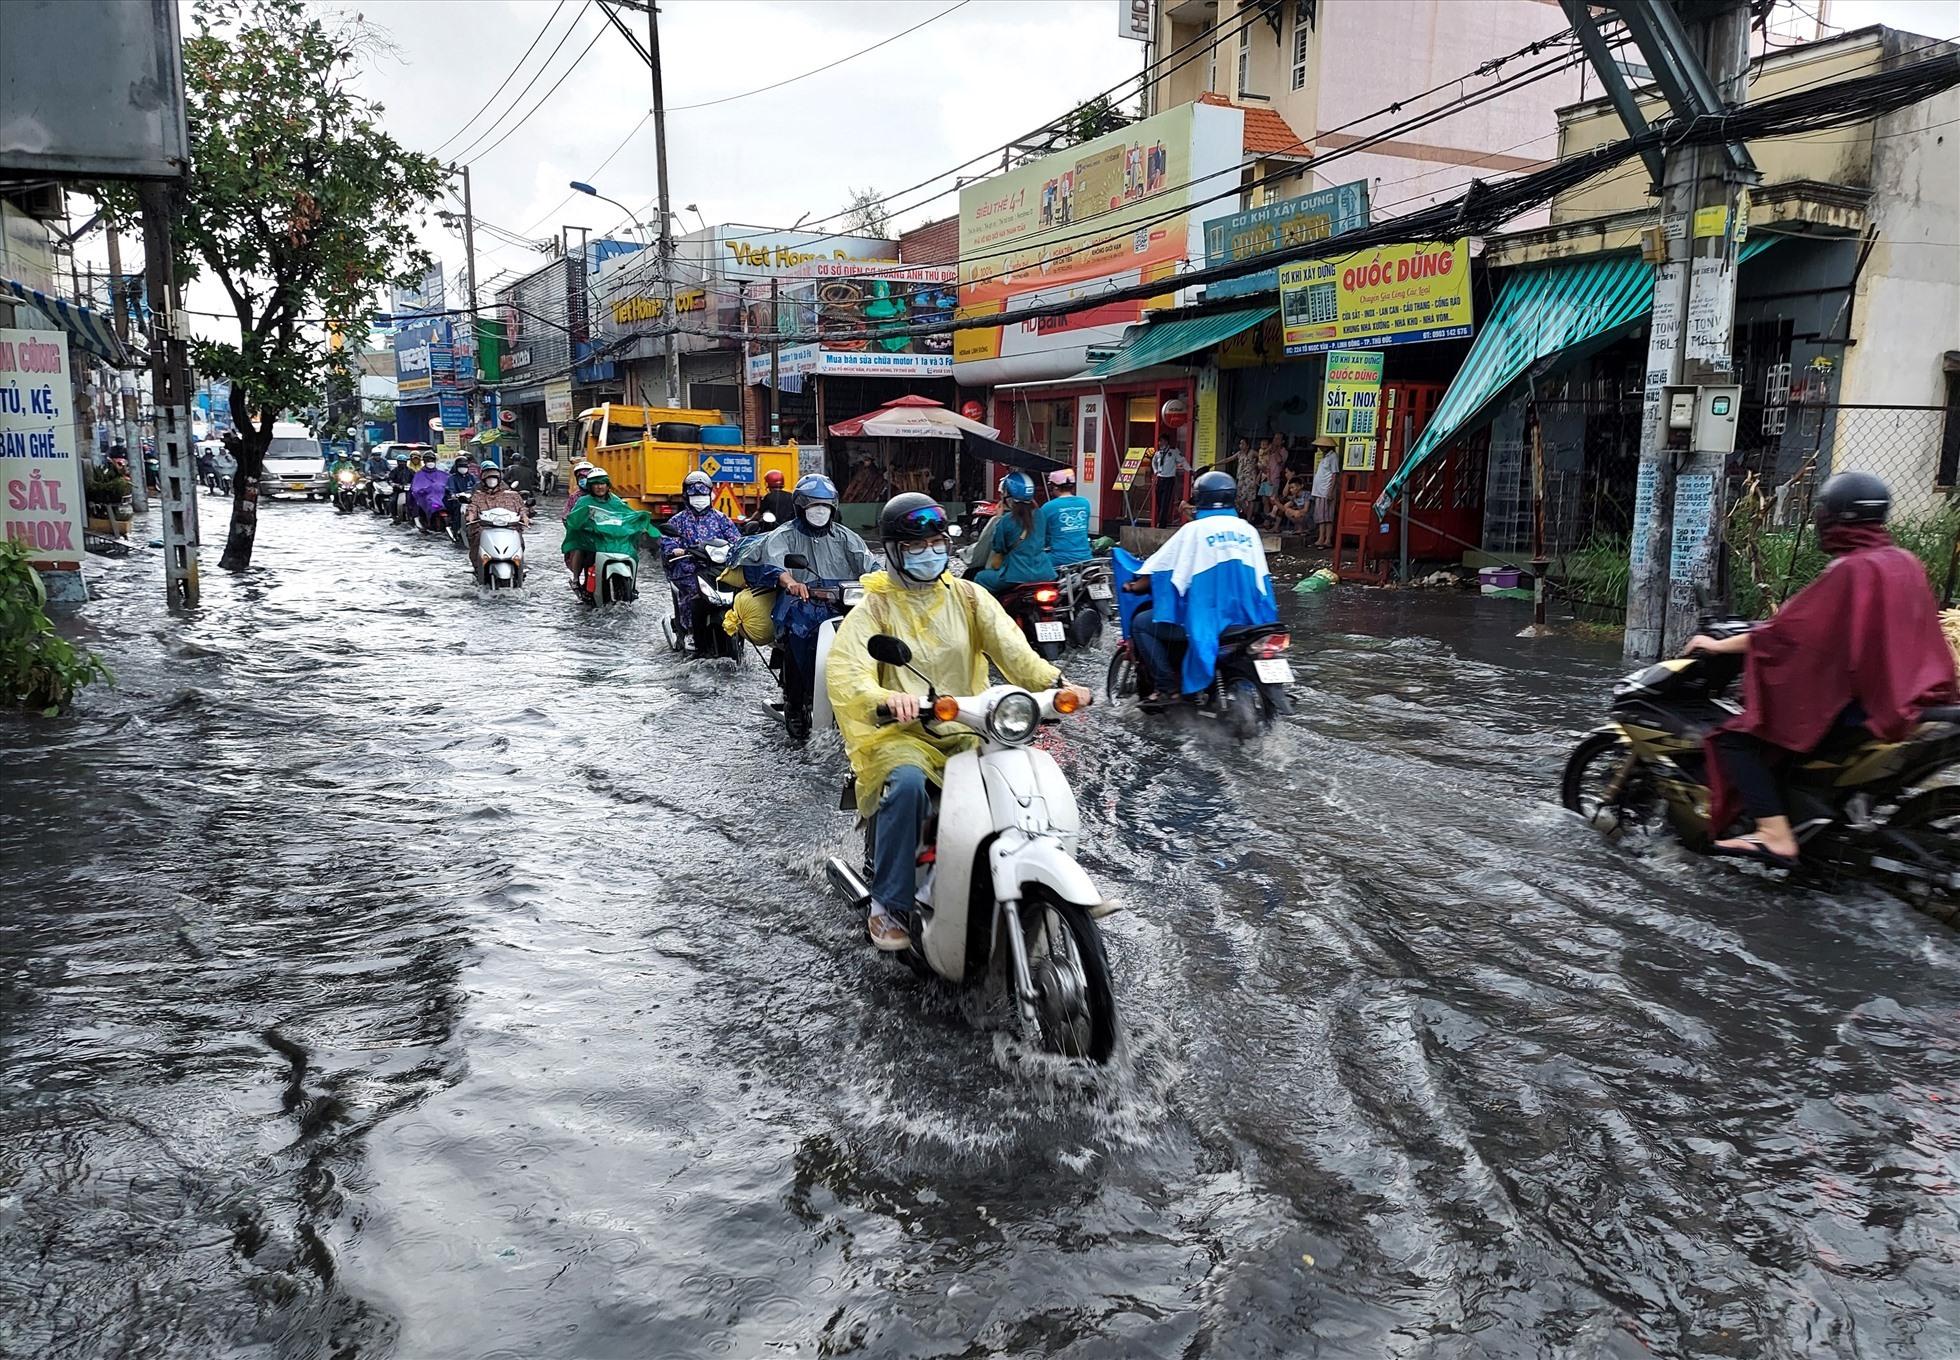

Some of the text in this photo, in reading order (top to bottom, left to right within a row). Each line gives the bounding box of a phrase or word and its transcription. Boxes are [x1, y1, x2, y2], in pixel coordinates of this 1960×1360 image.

[1274, 202, 1296, 218] XÂY
[1301, 194, 1334, 212] DỰNG
[725, 240, 770, 267] Viet
[1343, 250, 1453, 294] QUỐC DŨNG
[1021, 315, 1068, 334] HDBank
[18, 336, 61, 374] CÔNG
[893, 356, 913, 365] motor
[31, 384, 58, 420] KỆ,
[1327, 385, 1347, 407] SẮT
[1353, 391, 1377, 408] INOX
[8, 468, 67, 515] SẮT,
